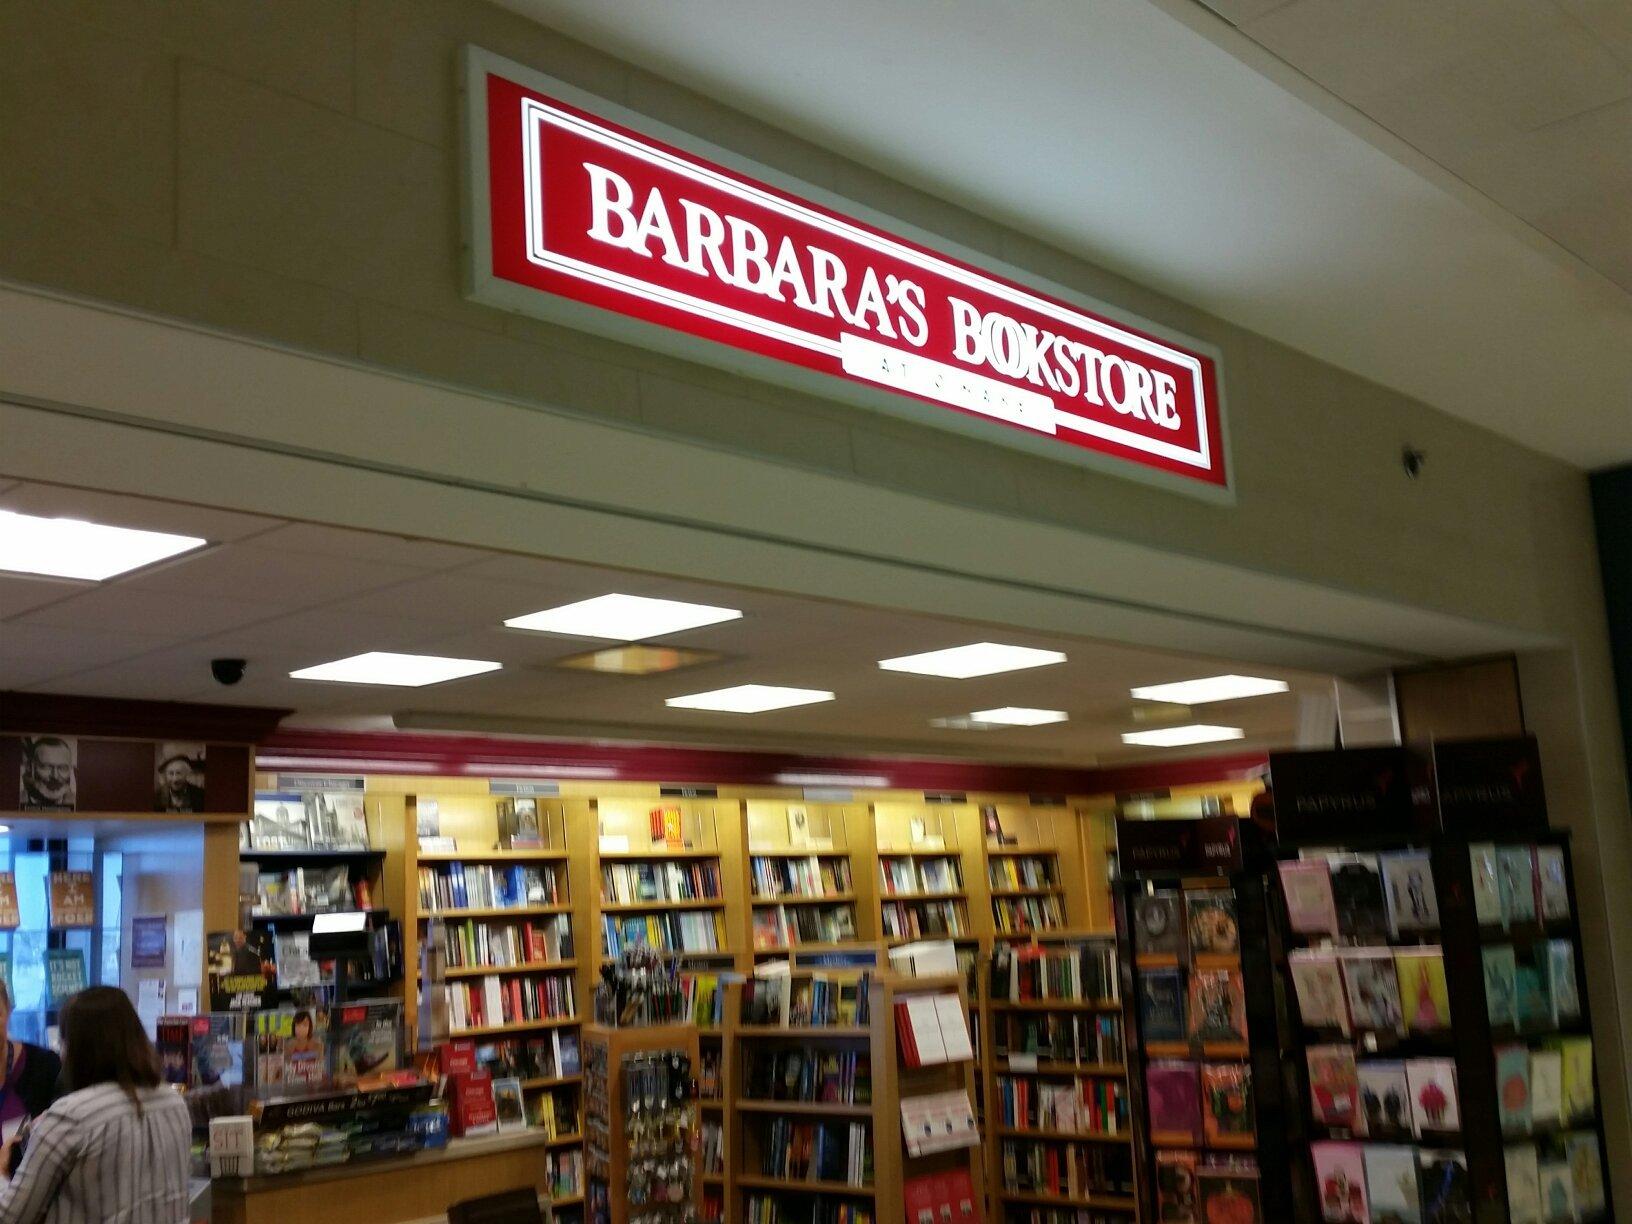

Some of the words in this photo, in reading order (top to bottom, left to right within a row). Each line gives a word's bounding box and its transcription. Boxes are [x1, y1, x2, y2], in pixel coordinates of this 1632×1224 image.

[582, 161, 928, 348] BARBARA'S
[947, 295, 1182, 431] BOOKSTORE
[63, 895, 85, 907] AM
